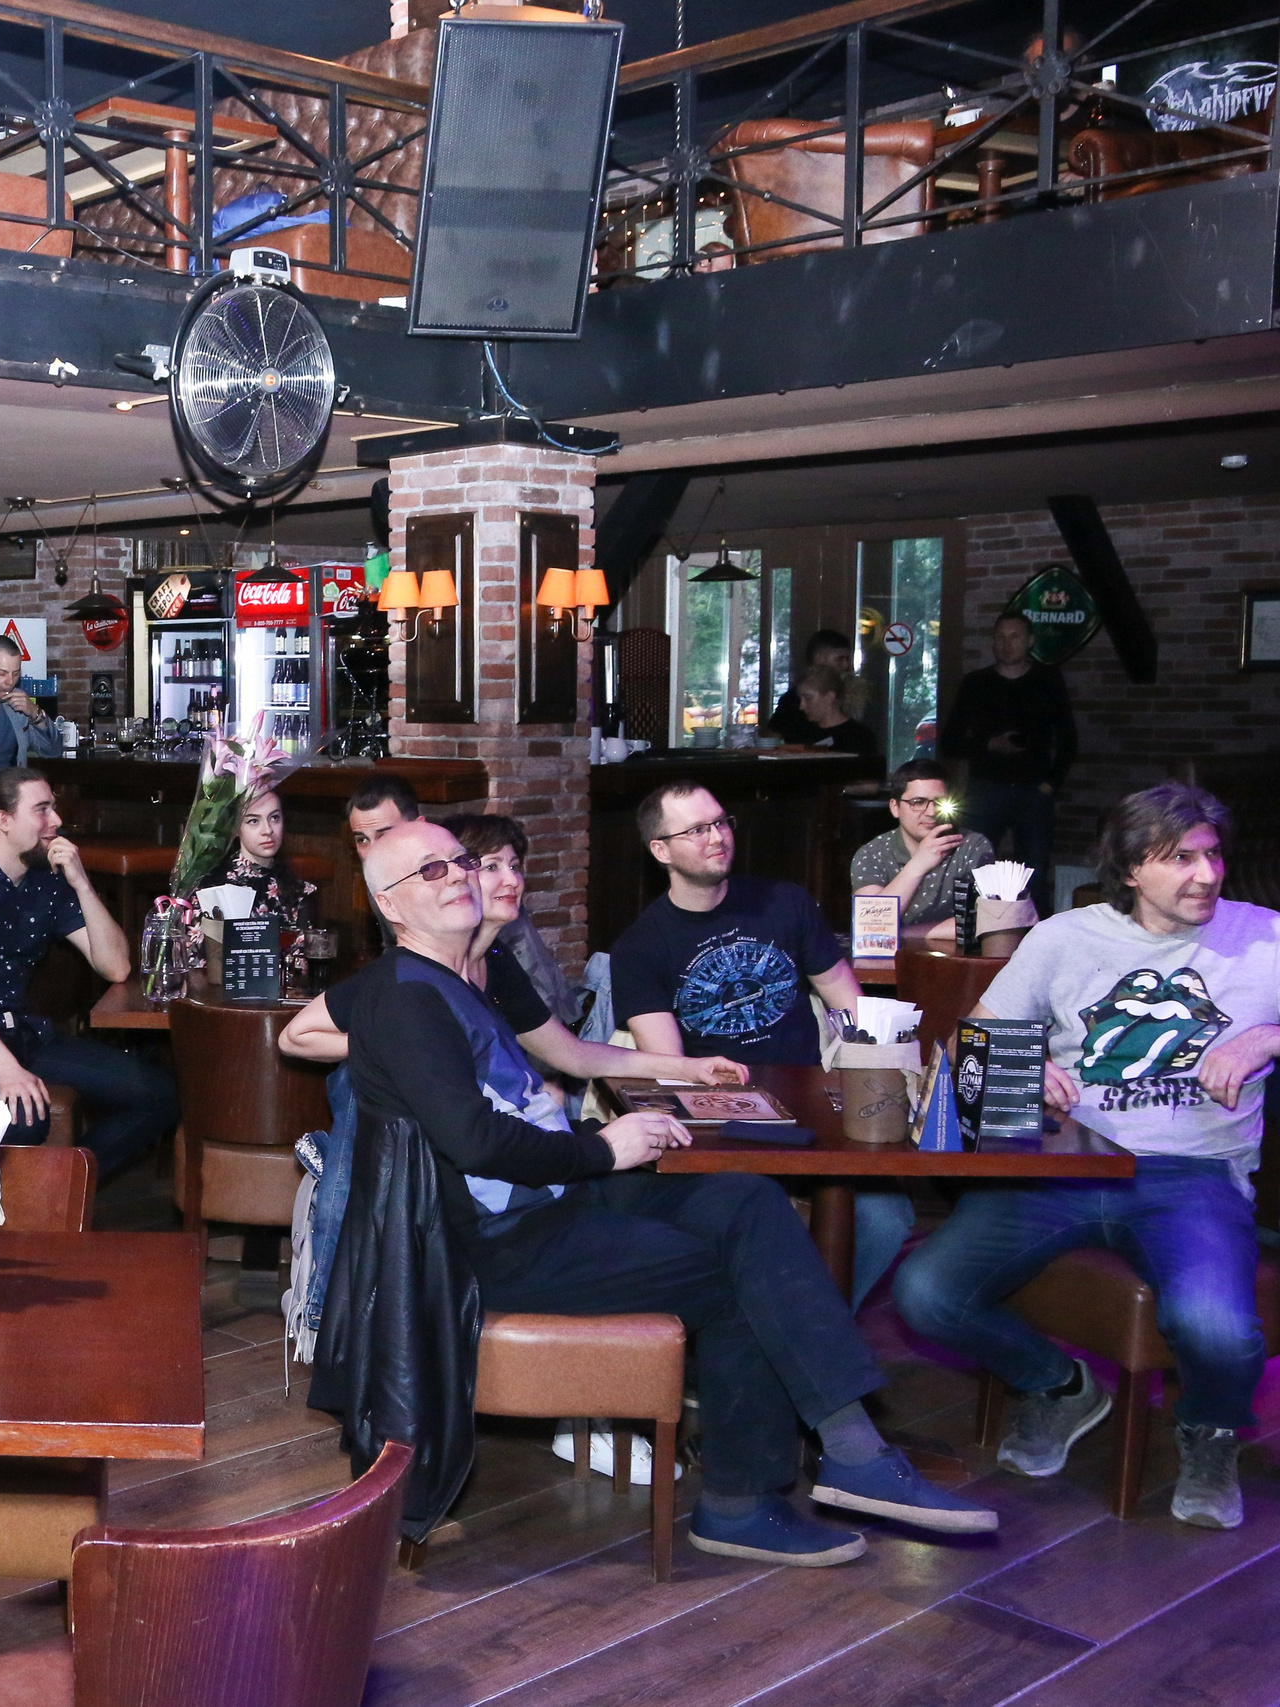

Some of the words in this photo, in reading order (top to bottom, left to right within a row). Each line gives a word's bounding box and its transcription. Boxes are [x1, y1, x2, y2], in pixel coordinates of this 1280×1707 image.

[150, 580, 171, 609] CRAFT
[156, 590, 175, 618] DEPOT
[238, 581, 292, 606] Coca-Cola
[958, 1073, 983, 1085] БАУМАН
